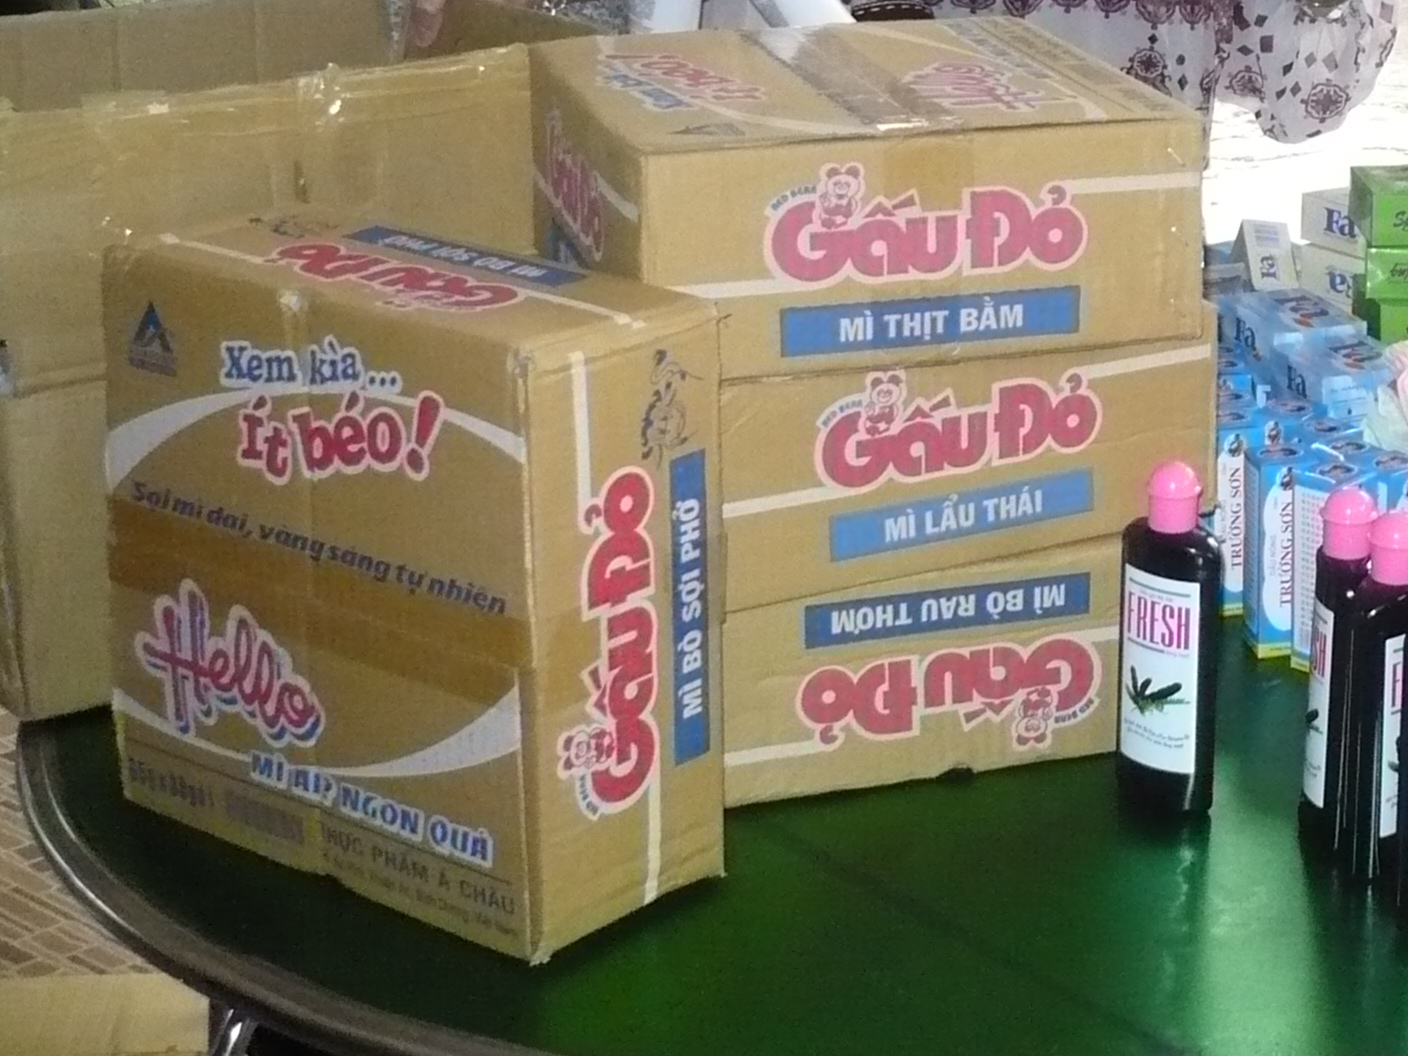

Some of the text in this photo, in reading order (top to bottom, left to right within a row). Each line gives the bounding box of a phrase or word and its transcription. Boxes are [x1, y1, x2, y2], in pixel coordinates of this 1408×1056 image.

[771, 184, 1084, 283] Gấu Đỏ
[1324, 207, 1357, 239] Fa
[839, 310, 874, 343] MÌ
[884, 310, 949, 341] THỊT
[225, 345, 297, 382] Xem
[292, 392, 441, 475] béo!
[822, 373, 1098, 488] Gấu Đỏ
[1228, 467, 1242, 498] SƠN
[884, 486, 1043, 543] MÌ LẨU THÁI
[672, 497, 704, 720] MÌ BÒ SỢI PHỞ
[831, 583, 1066, 635] MÌ BÒ RAU THƠM
[1127, 590, 1191, 651] FRESH
[142, 590, 321, 742] Hello
[340, 786, 419, 836] NGON
